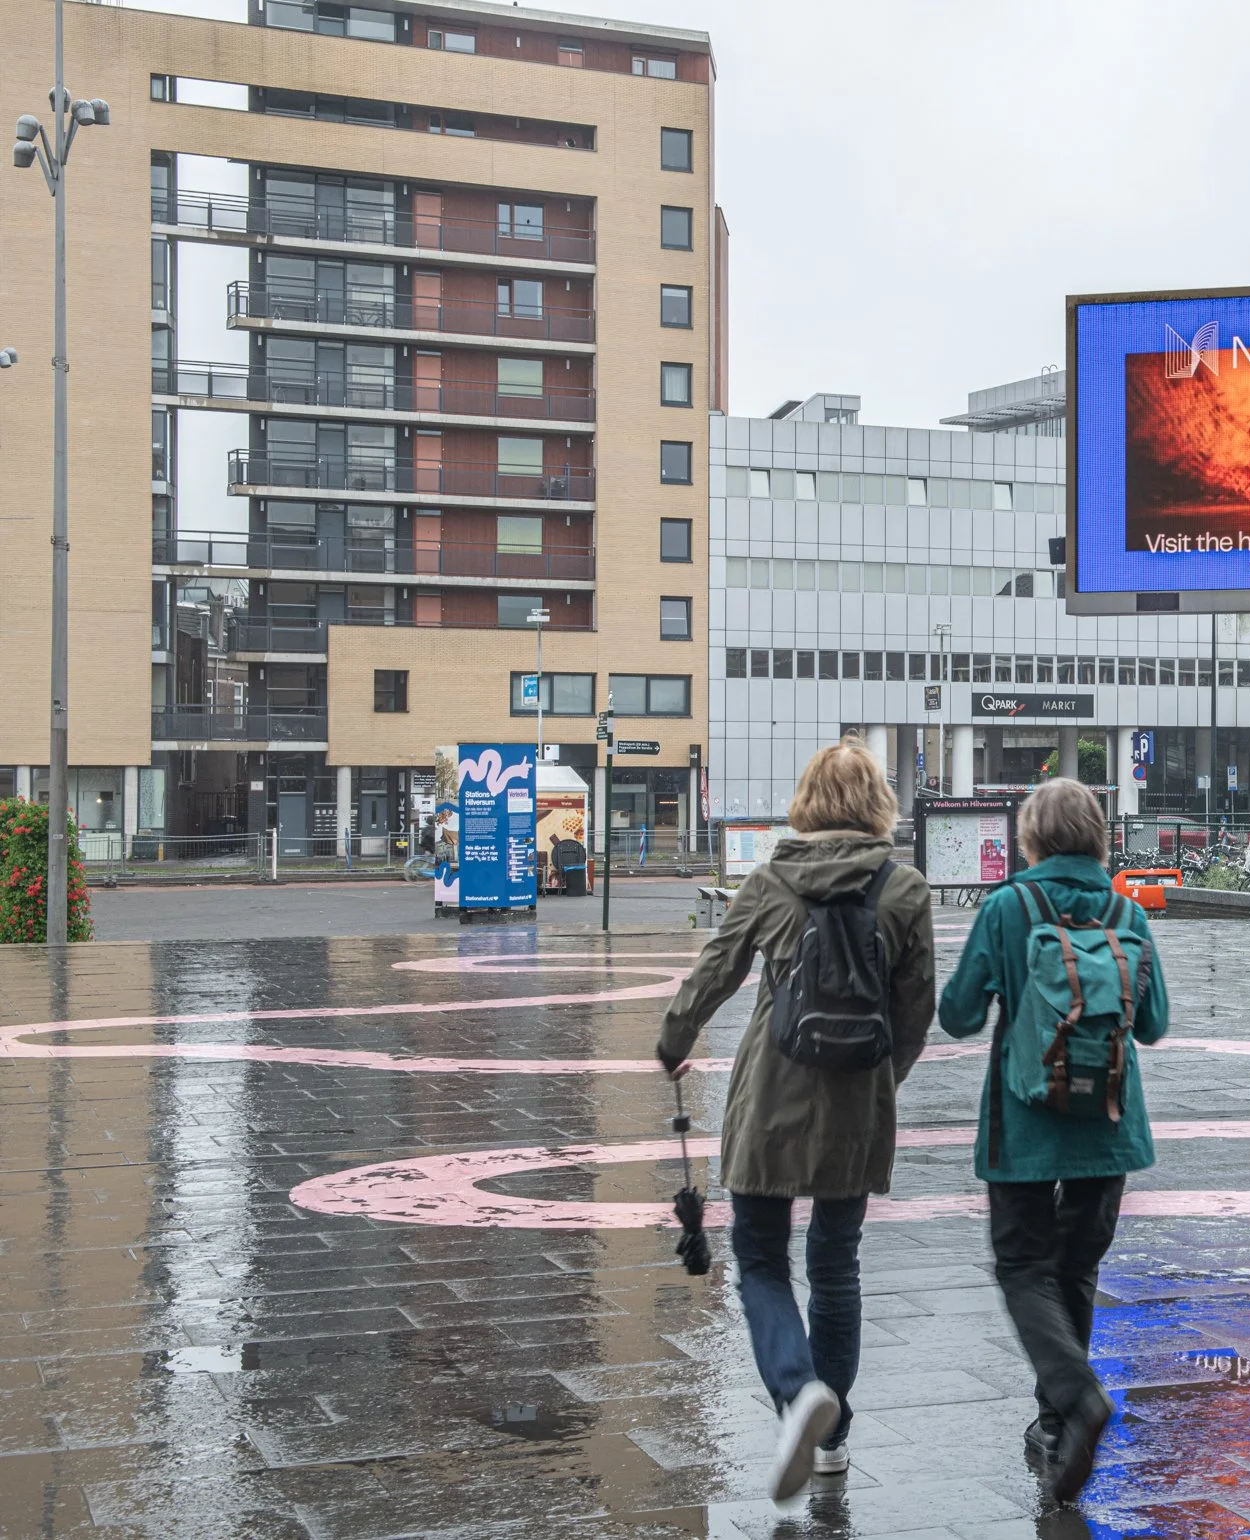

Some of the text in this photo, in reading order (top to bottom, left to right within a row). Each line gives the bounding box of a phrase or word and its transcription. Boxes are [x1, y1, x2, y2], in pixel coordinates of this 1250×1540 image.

[1145, 532, 1192, 554] Visit
[1195, 531, 1233, 553] the
[1042, 700, 1076, 711] MARKT
[1140, 738, 1149, 761] P
[465, 790, 490, 798] Stations
[465, 798, 496, 806] Hilversum
